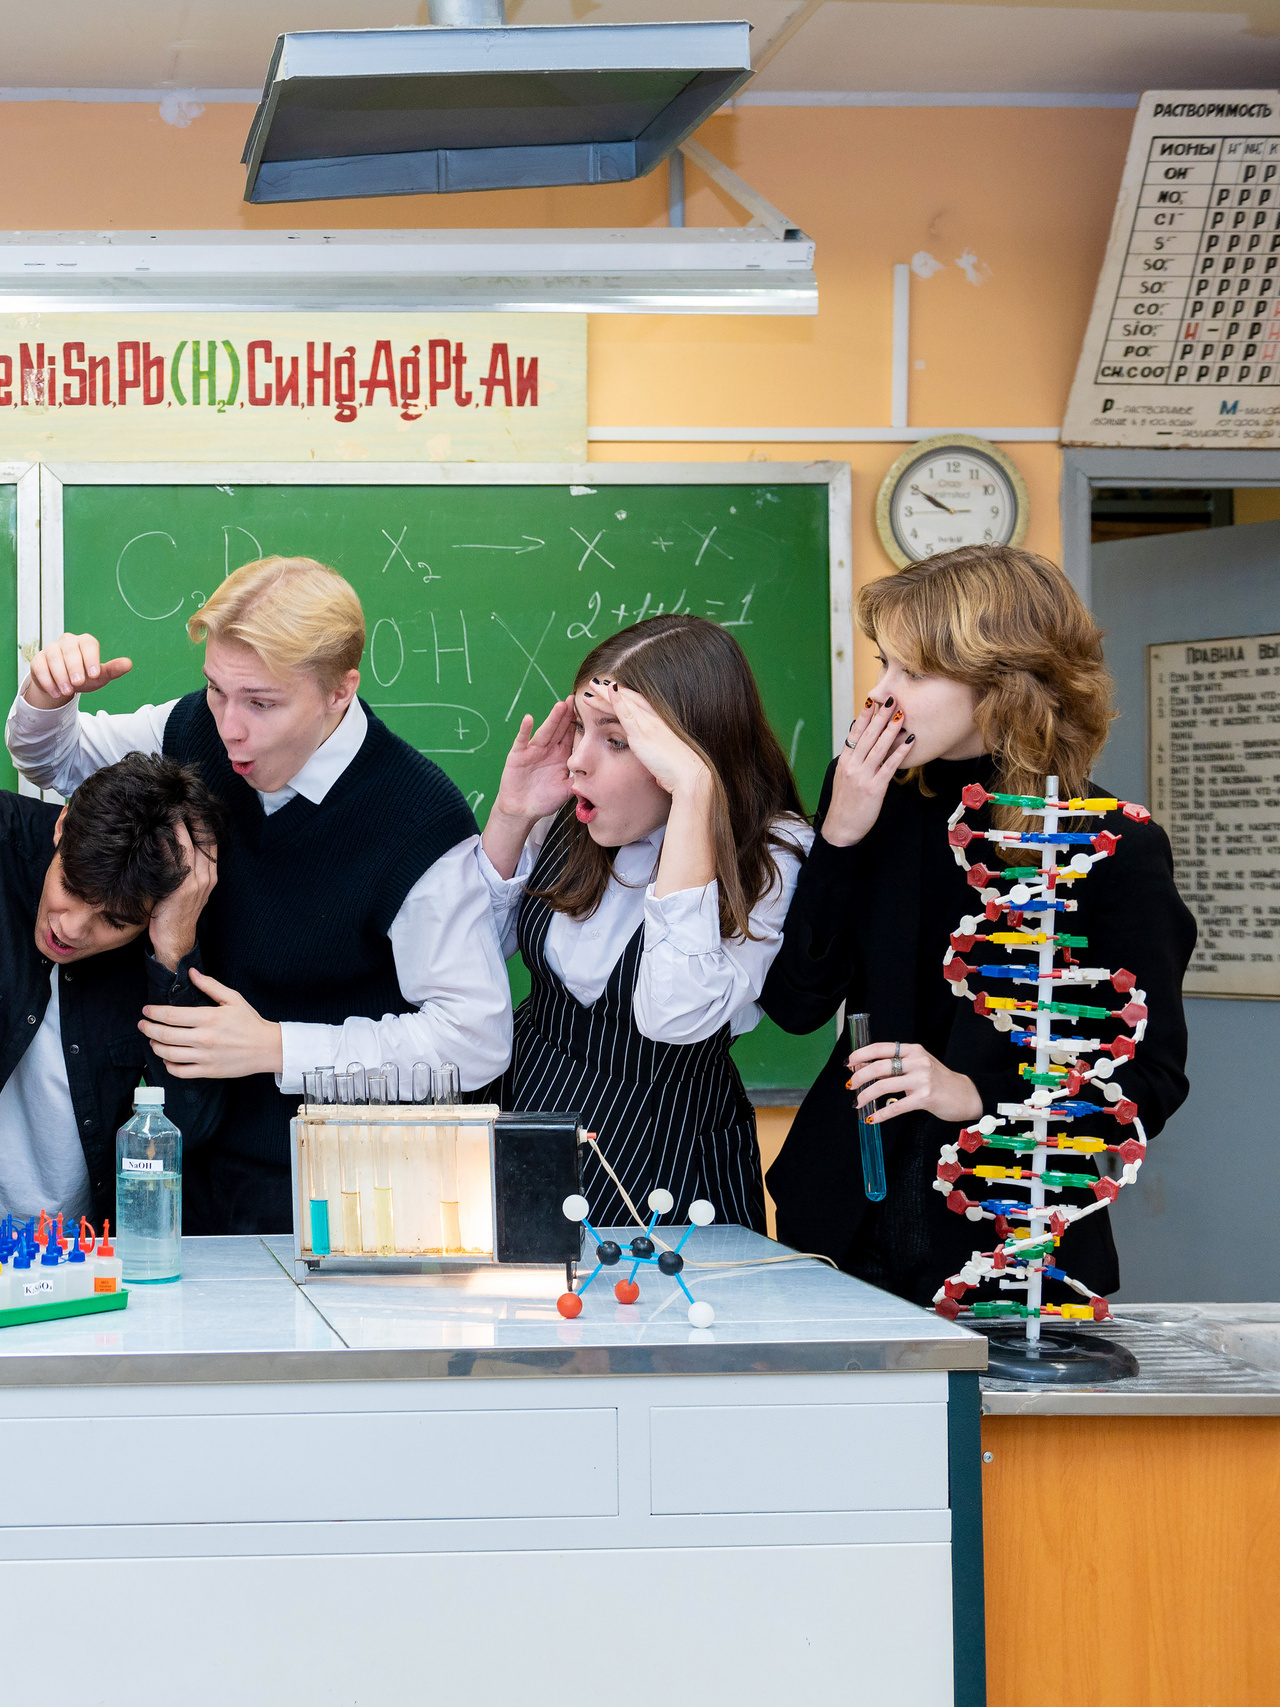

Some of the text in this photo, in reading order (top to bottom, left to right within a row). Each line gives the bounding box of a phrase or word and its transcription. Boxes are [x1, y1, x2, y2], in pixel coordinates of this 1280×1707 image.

[1153, 103, 1272, 118] РАСТВОРИМОСТЬ
[1159, 143, 1216, 156] ИОНЫ
[1186, 646, 1244, 663] ПРАВИЛА
[128, 1161, 152, 1170] NaOH
